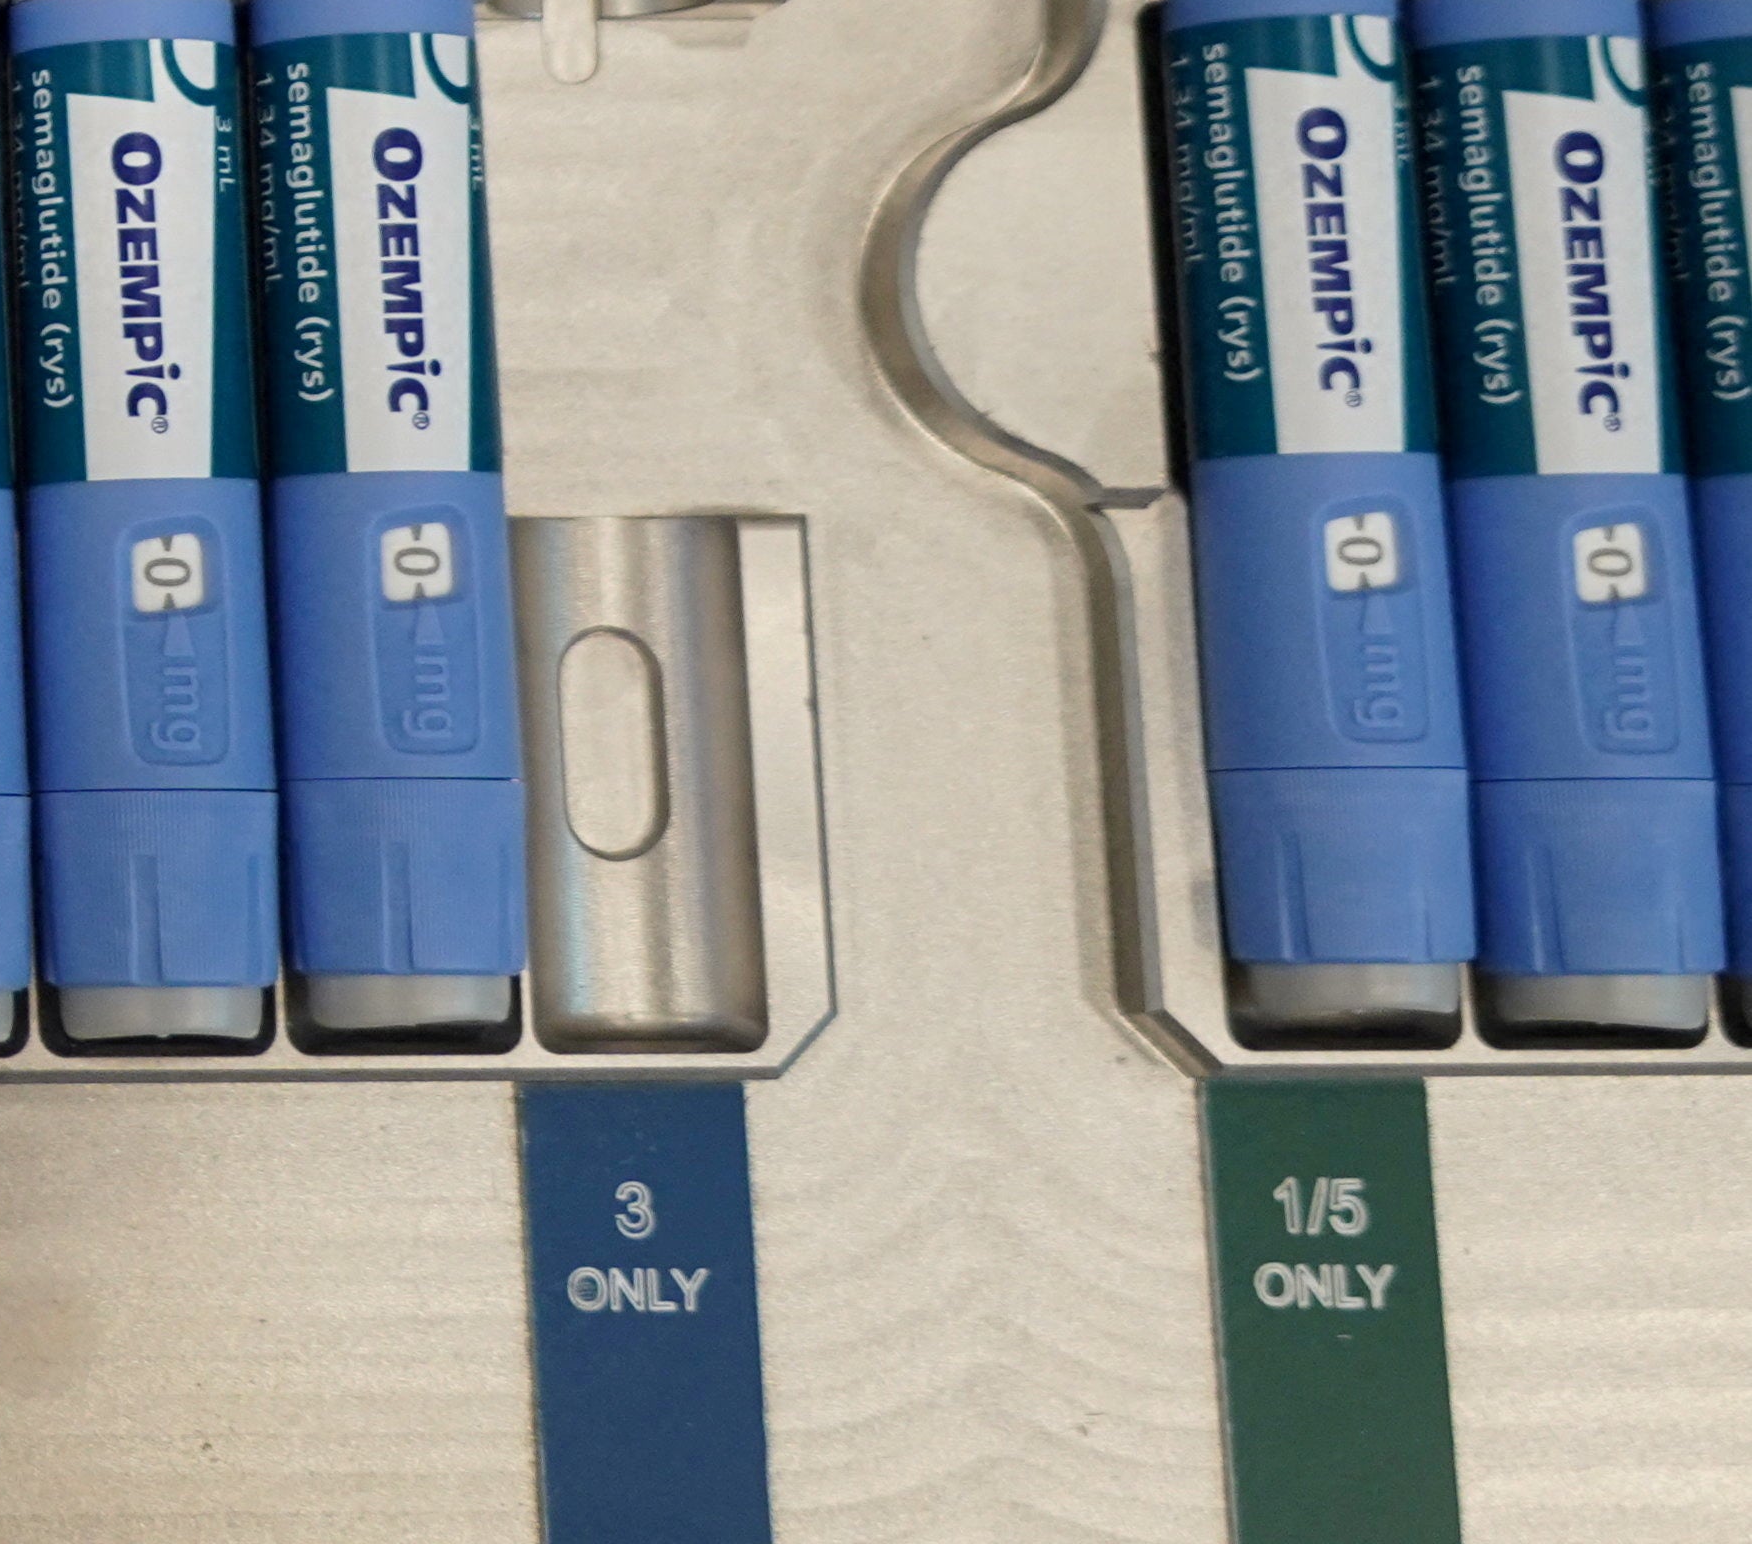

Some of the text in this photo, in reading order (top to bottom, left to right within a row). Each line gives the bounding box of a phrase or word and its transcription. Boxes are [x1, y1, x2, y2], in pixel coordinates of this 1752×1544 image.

[217, 115, 236, 193] 3 mL
[33, 70, 73, 407] semaglutide (rys)
[287, 64, 333, 401] semaglutide (rys)
[1205, 44, 1261, 380] semaglutide (rys)
[1458, 66, 1521, 403] semaglutide (rys)
[144, 558, 192, 587] 0
[394, 548, 440, 576] 0
[1338, 537, 1383, 566] 0
[1588, 548, 1633, 577] 0
[151, 663, 199, 748] mg
[402, 654, 452, 738] mg
[615, 1181, 656, 1240] 3
[1273, 1176, 1369, 1236] 1/5
[567, 1266, 711, 1313] ONLY
[1253, 1262, 1396, 1308] ONLY
